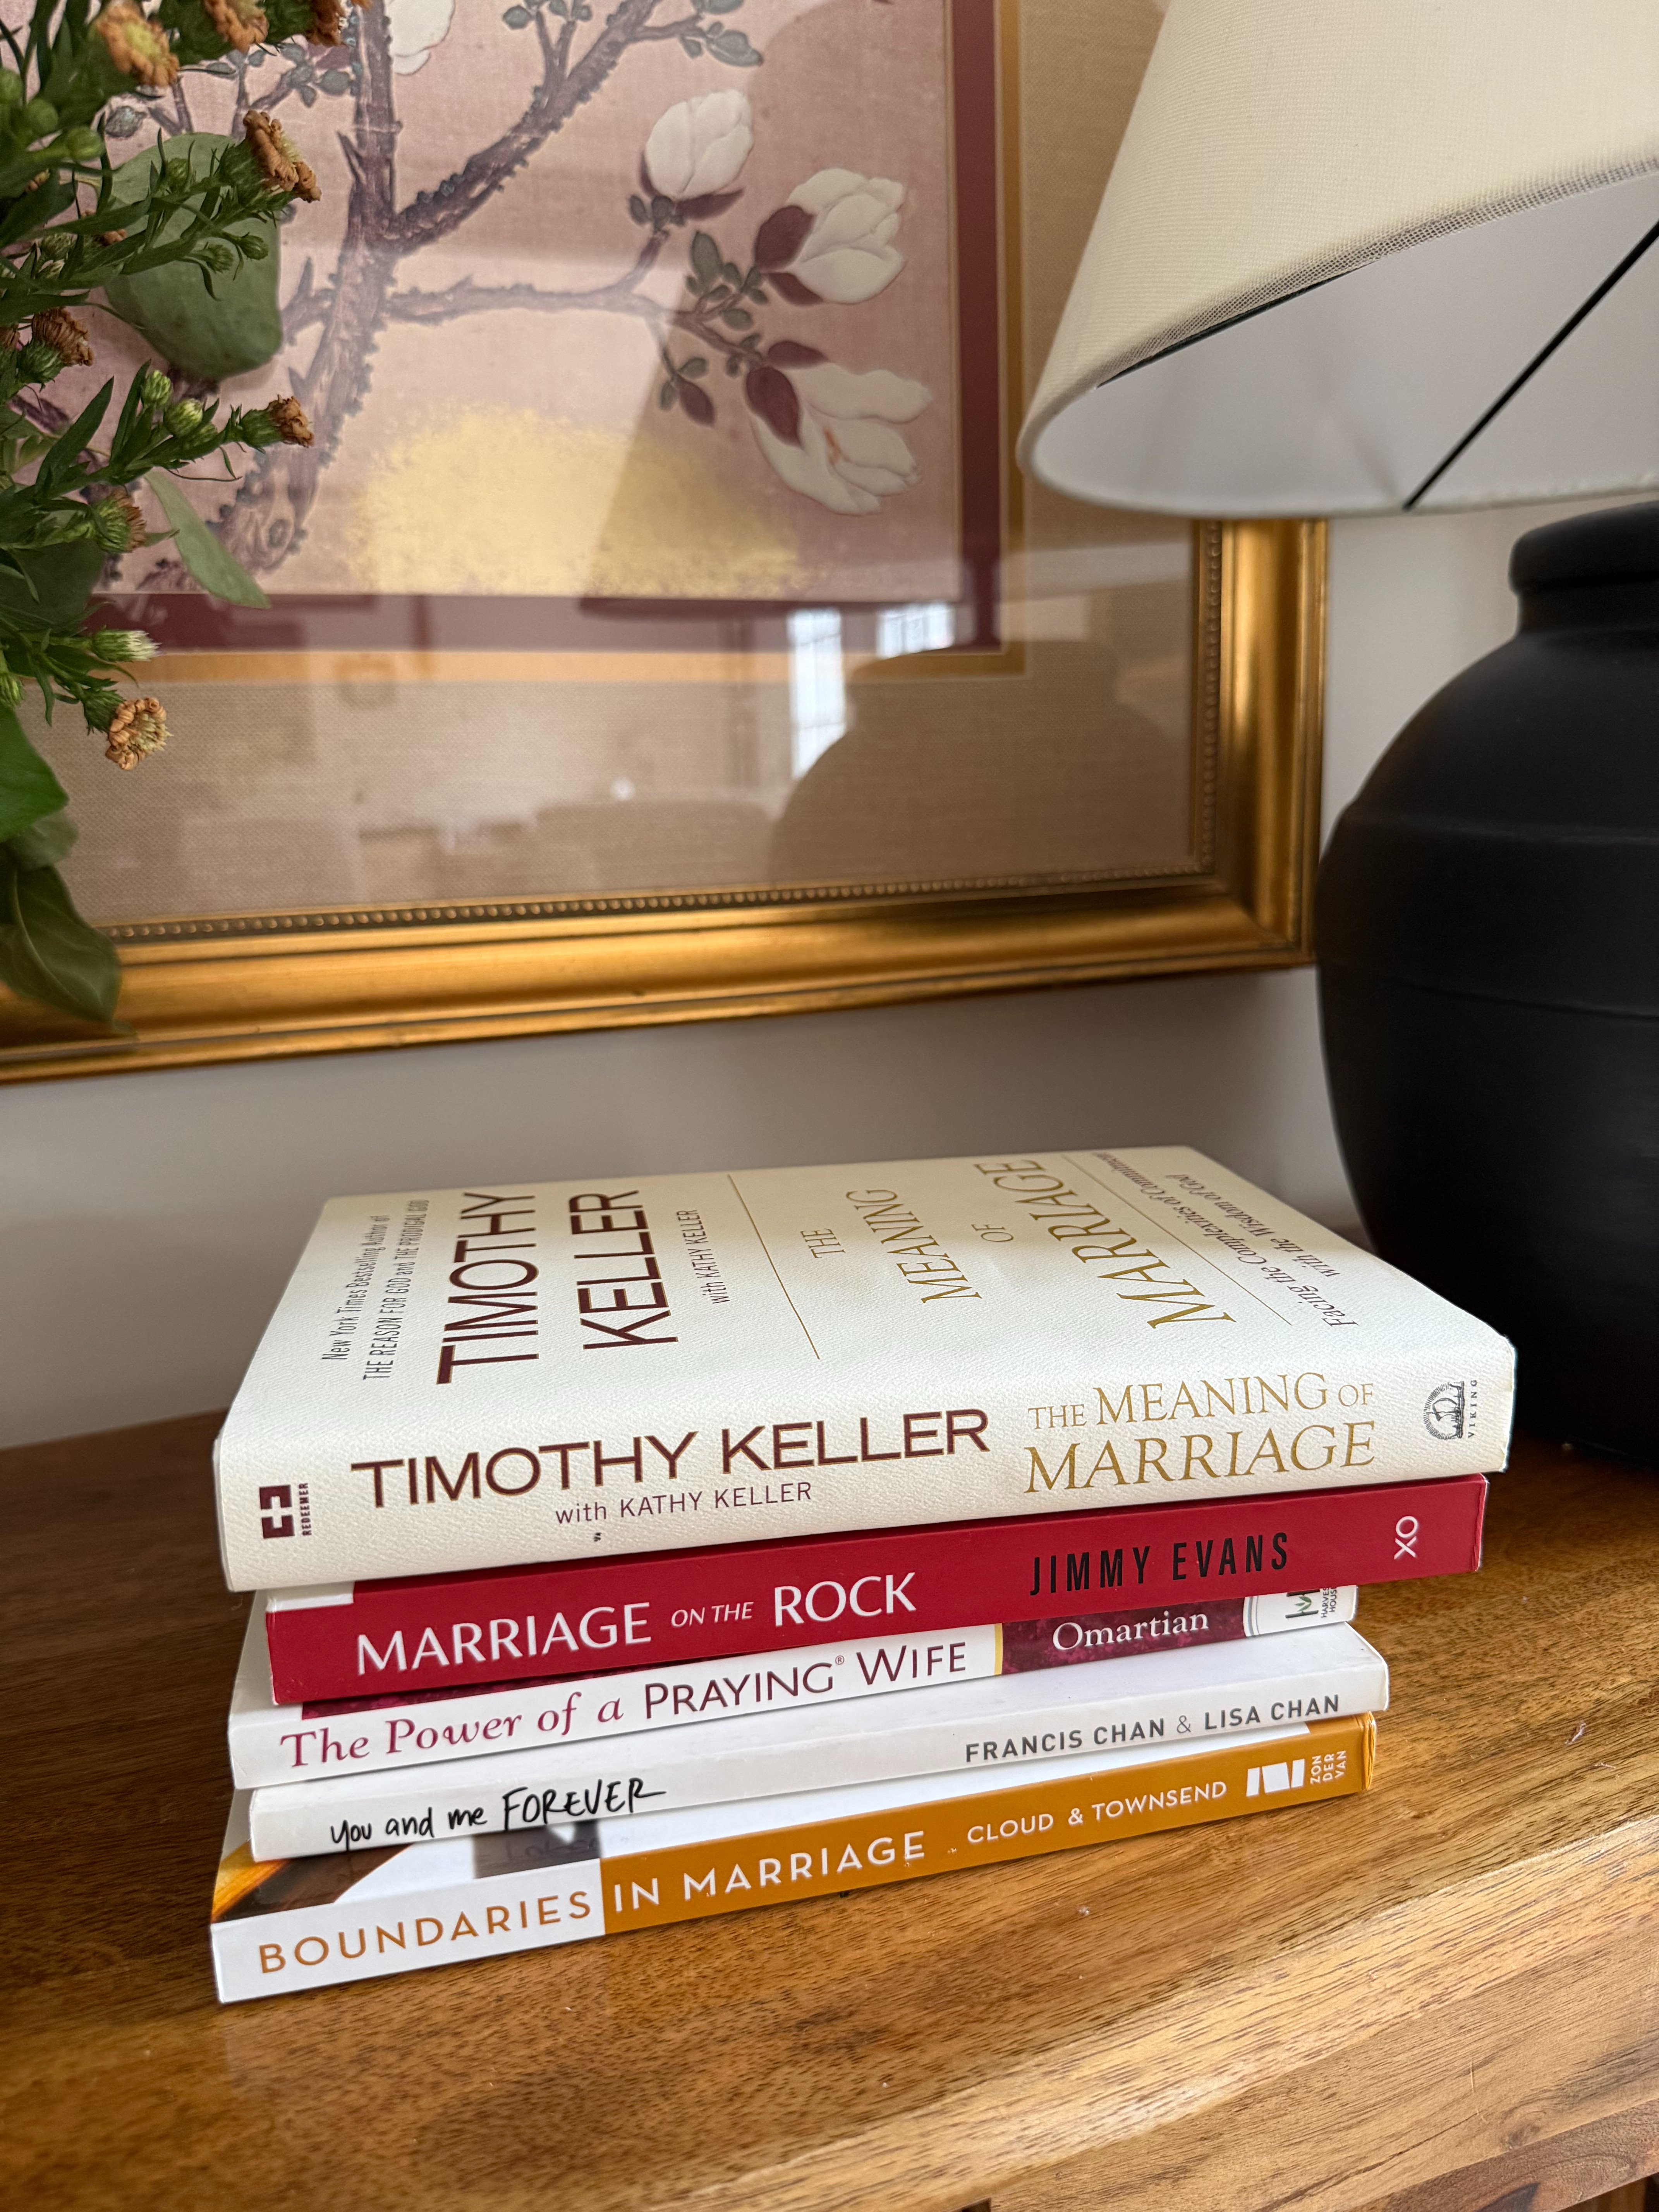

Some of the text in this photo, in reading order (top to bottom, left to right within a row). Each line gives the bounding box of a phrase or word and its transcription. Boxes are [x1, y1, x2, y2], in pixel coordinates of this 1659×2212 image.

[1149, 1196, 1180, 1205] of
[361, 1224, 388, 1245] Author
[399, 1214, 427, 1245] PRODIGAL
[800, 1228, 845, 1259] THE
[846, 1189, 982, 1304] MEANING
[971, 1224, 1014, 1242] OF
[974, 1159, 1237, 1329] MARRIAGE
[1164, 1174, 1341, 1277] with the Wisdom of God
[1173, 1206, 1267, 1265] Complexities
[346, 1247, 386, 1288] Bestselling
[393, 1262, 416, 1275] and
[394, 1248, 419, 1259] THE
[569, 1190, 678, 1350] KELLER
[677, 1210, 730, 1304] with KATHY KELLER
[1261, 1266, 1295, 1283] the
[337, 1290, 368, 1314] Times
[380, 1297, 407, 1313] FOR
[385, 1278, 411, 1293] GOD
[436, 1192, 539, 1385] TIMOTHY
[1288, 1285, 1359, 1328] Facing
[330, 1316, 359, 1336] York
[369, 1317, 403, 1355] REASON
[322, 1340, 352, 1360] New
[363, 1360, 393, 1380] THE
[1028, 1372, 1374, 1429] THE MEANING OF
[1468, 1380, 1477, 1438] VIKING
[350, 1408, 990, 1508] TIMOTHY KELLER
[1024, 1420, 1374, 1493] MARRIAGE
[299, 1483, 312, 1536] REDEEMER
[555, 1482, 811, 1524] with KATHY KELLER
[1394, 1516, 1418, 1559] XO
[1030, 1532, 1288, 1596] JIMMY EVANS
[357, 1572, 916, 1676] MARRIAGE ON THE ROCK
[1053, 1605, 1209, 1651] Omartian
[280, 1728, 370, 1768] The
[385, 1715, 522, 1755] Power
[538, 1691, 582, 1736] of
[598, 1698, 624, 1723] a
[856, 1642, 966, 1686] WIFE
[966, 1694, 1339, 1762] FRANCIS CHAN & LISA CHAN
[1310, 1755, 1322, 1784] ZON
[1322, 1753, 1334, 1782] DER
[1335, 1750, 1347, 1778] VAN
[330, 1778, 666, 1850] you and me FOREVER
[967, 1781, 1227, 1844] CLOUD & TOWNSEND
[259, 1831, 925, 1974] BOUNDARIES IN MARRIAGE
